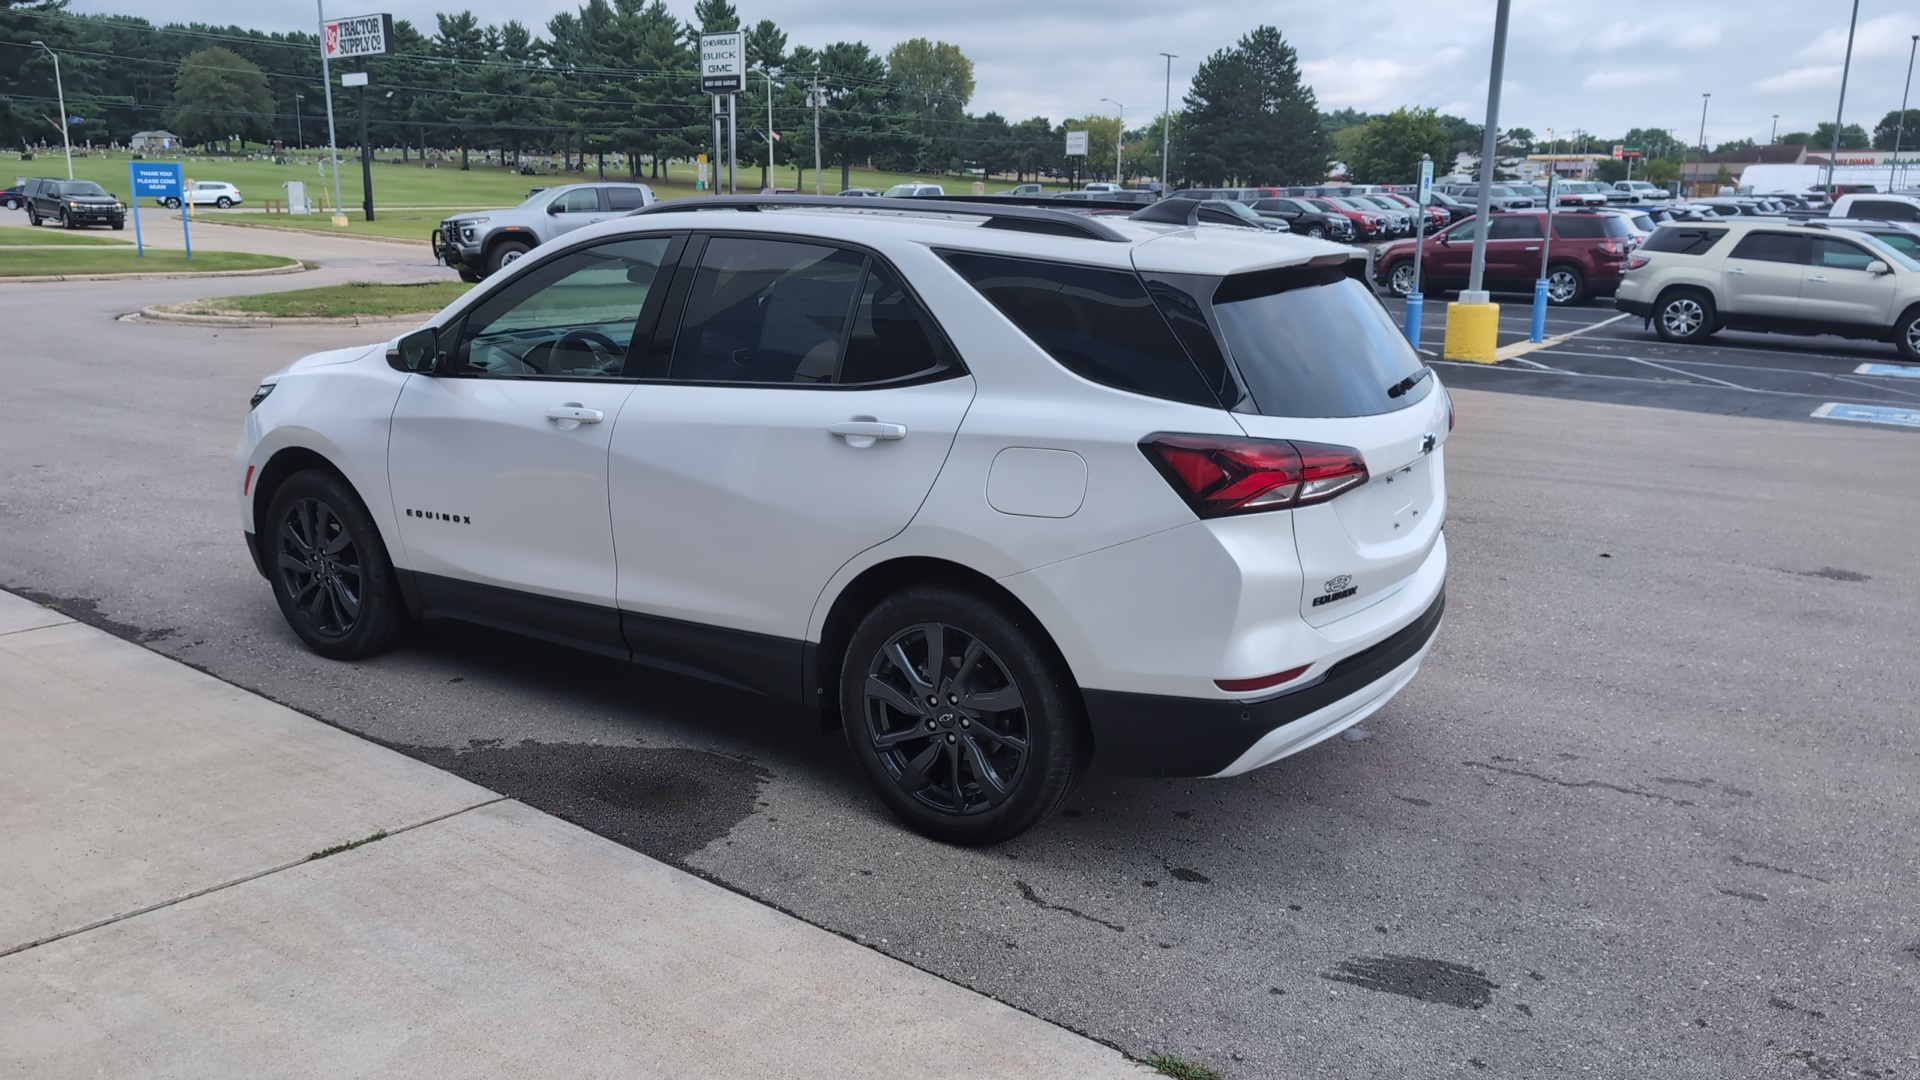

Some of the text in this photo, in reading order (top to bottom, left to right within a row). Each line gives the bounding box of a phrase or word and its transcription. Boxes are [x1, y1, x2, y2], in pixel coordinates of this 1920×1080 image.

[338, 18, 380, 37] TRACTOR
[340, 36, 370, 54] SUPPLY
[703, 38, 736, 47] CHEVROLET
[703, 51, 737, 60] BUICK
[708, 64, 732, 73] GMC
[406, 508, 471, 524] EQUINOX
[1312, 585, 1358, 607] EQUINOX
